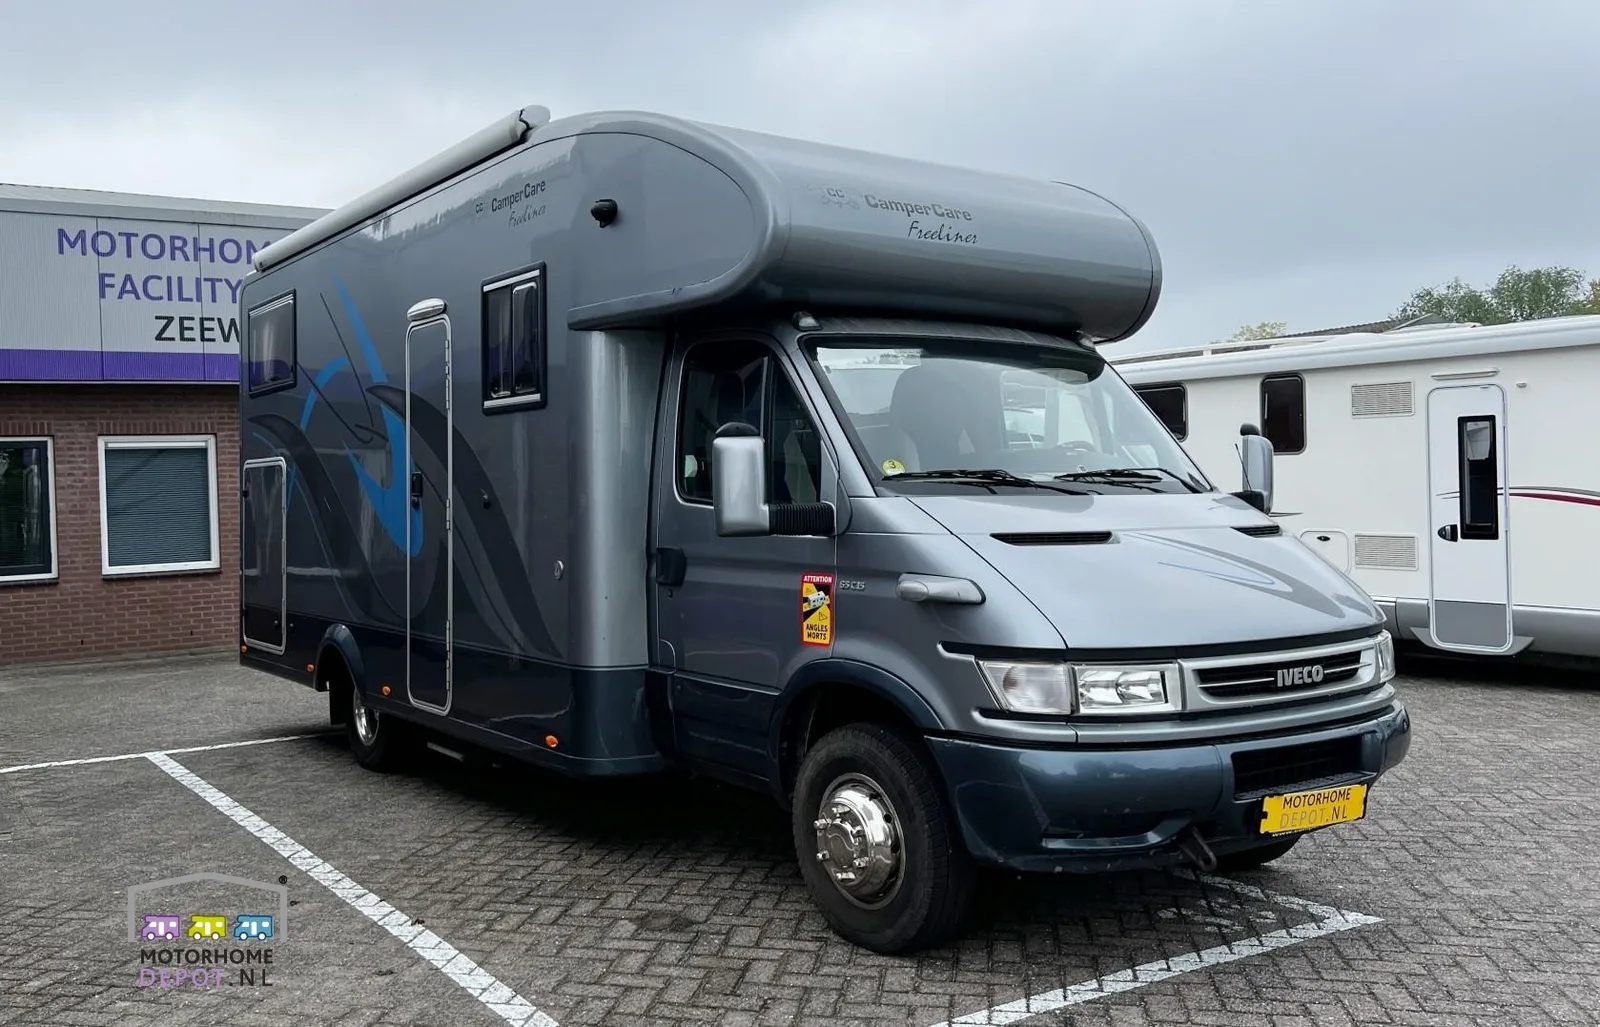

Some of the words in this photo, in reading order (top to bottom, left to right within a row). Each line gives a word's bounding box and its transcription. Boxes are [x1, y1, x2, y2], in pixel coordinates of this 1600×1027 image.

[491, 180, 546, 213] CamperCare
[864, 194, 973, 221] CamperCare
[907, 220, 979, 244] Freeliner
[99, 272, 243, 304] FACILITY
[154, 315, 240, 343] ZEEW
[803, 575, 832, 583] ATTENTION
[806, 623, 828, 632] ANGLES
[807, 631, 827, 640] MORTS
[1277, 665, 1324, 687] IVECO
[1282, 788, 1351, 809] MOTORHOME
[1280, 805, 1347, 829] DEPOT.NL
